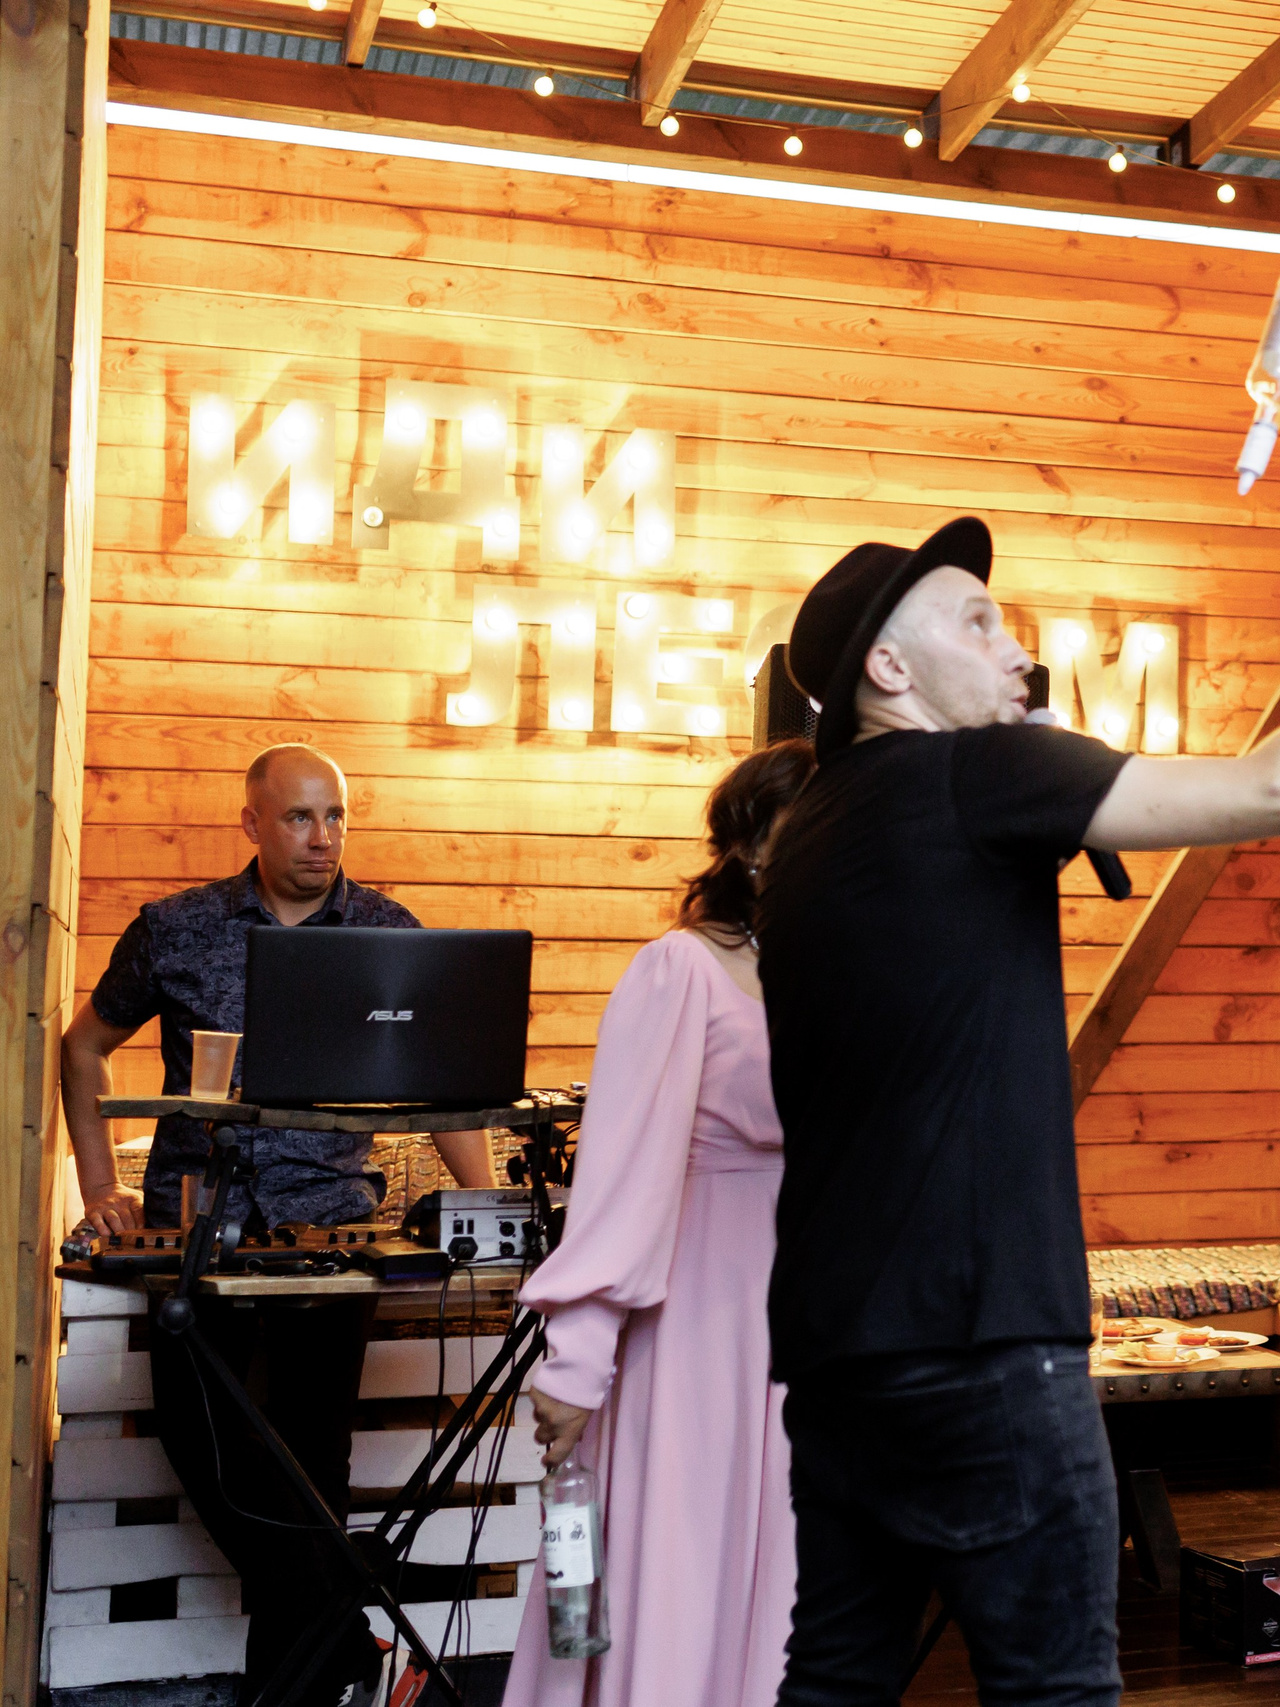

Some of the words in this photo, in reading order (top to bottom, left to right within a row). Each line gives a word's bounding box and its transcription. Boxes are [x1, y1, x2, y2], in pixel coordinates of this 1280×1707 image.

[186, 378, 676, 564] ИДИ
[446, 584, 1180, 755] ЛЕМ
[366, 1010, 414, 1021] ASUS
